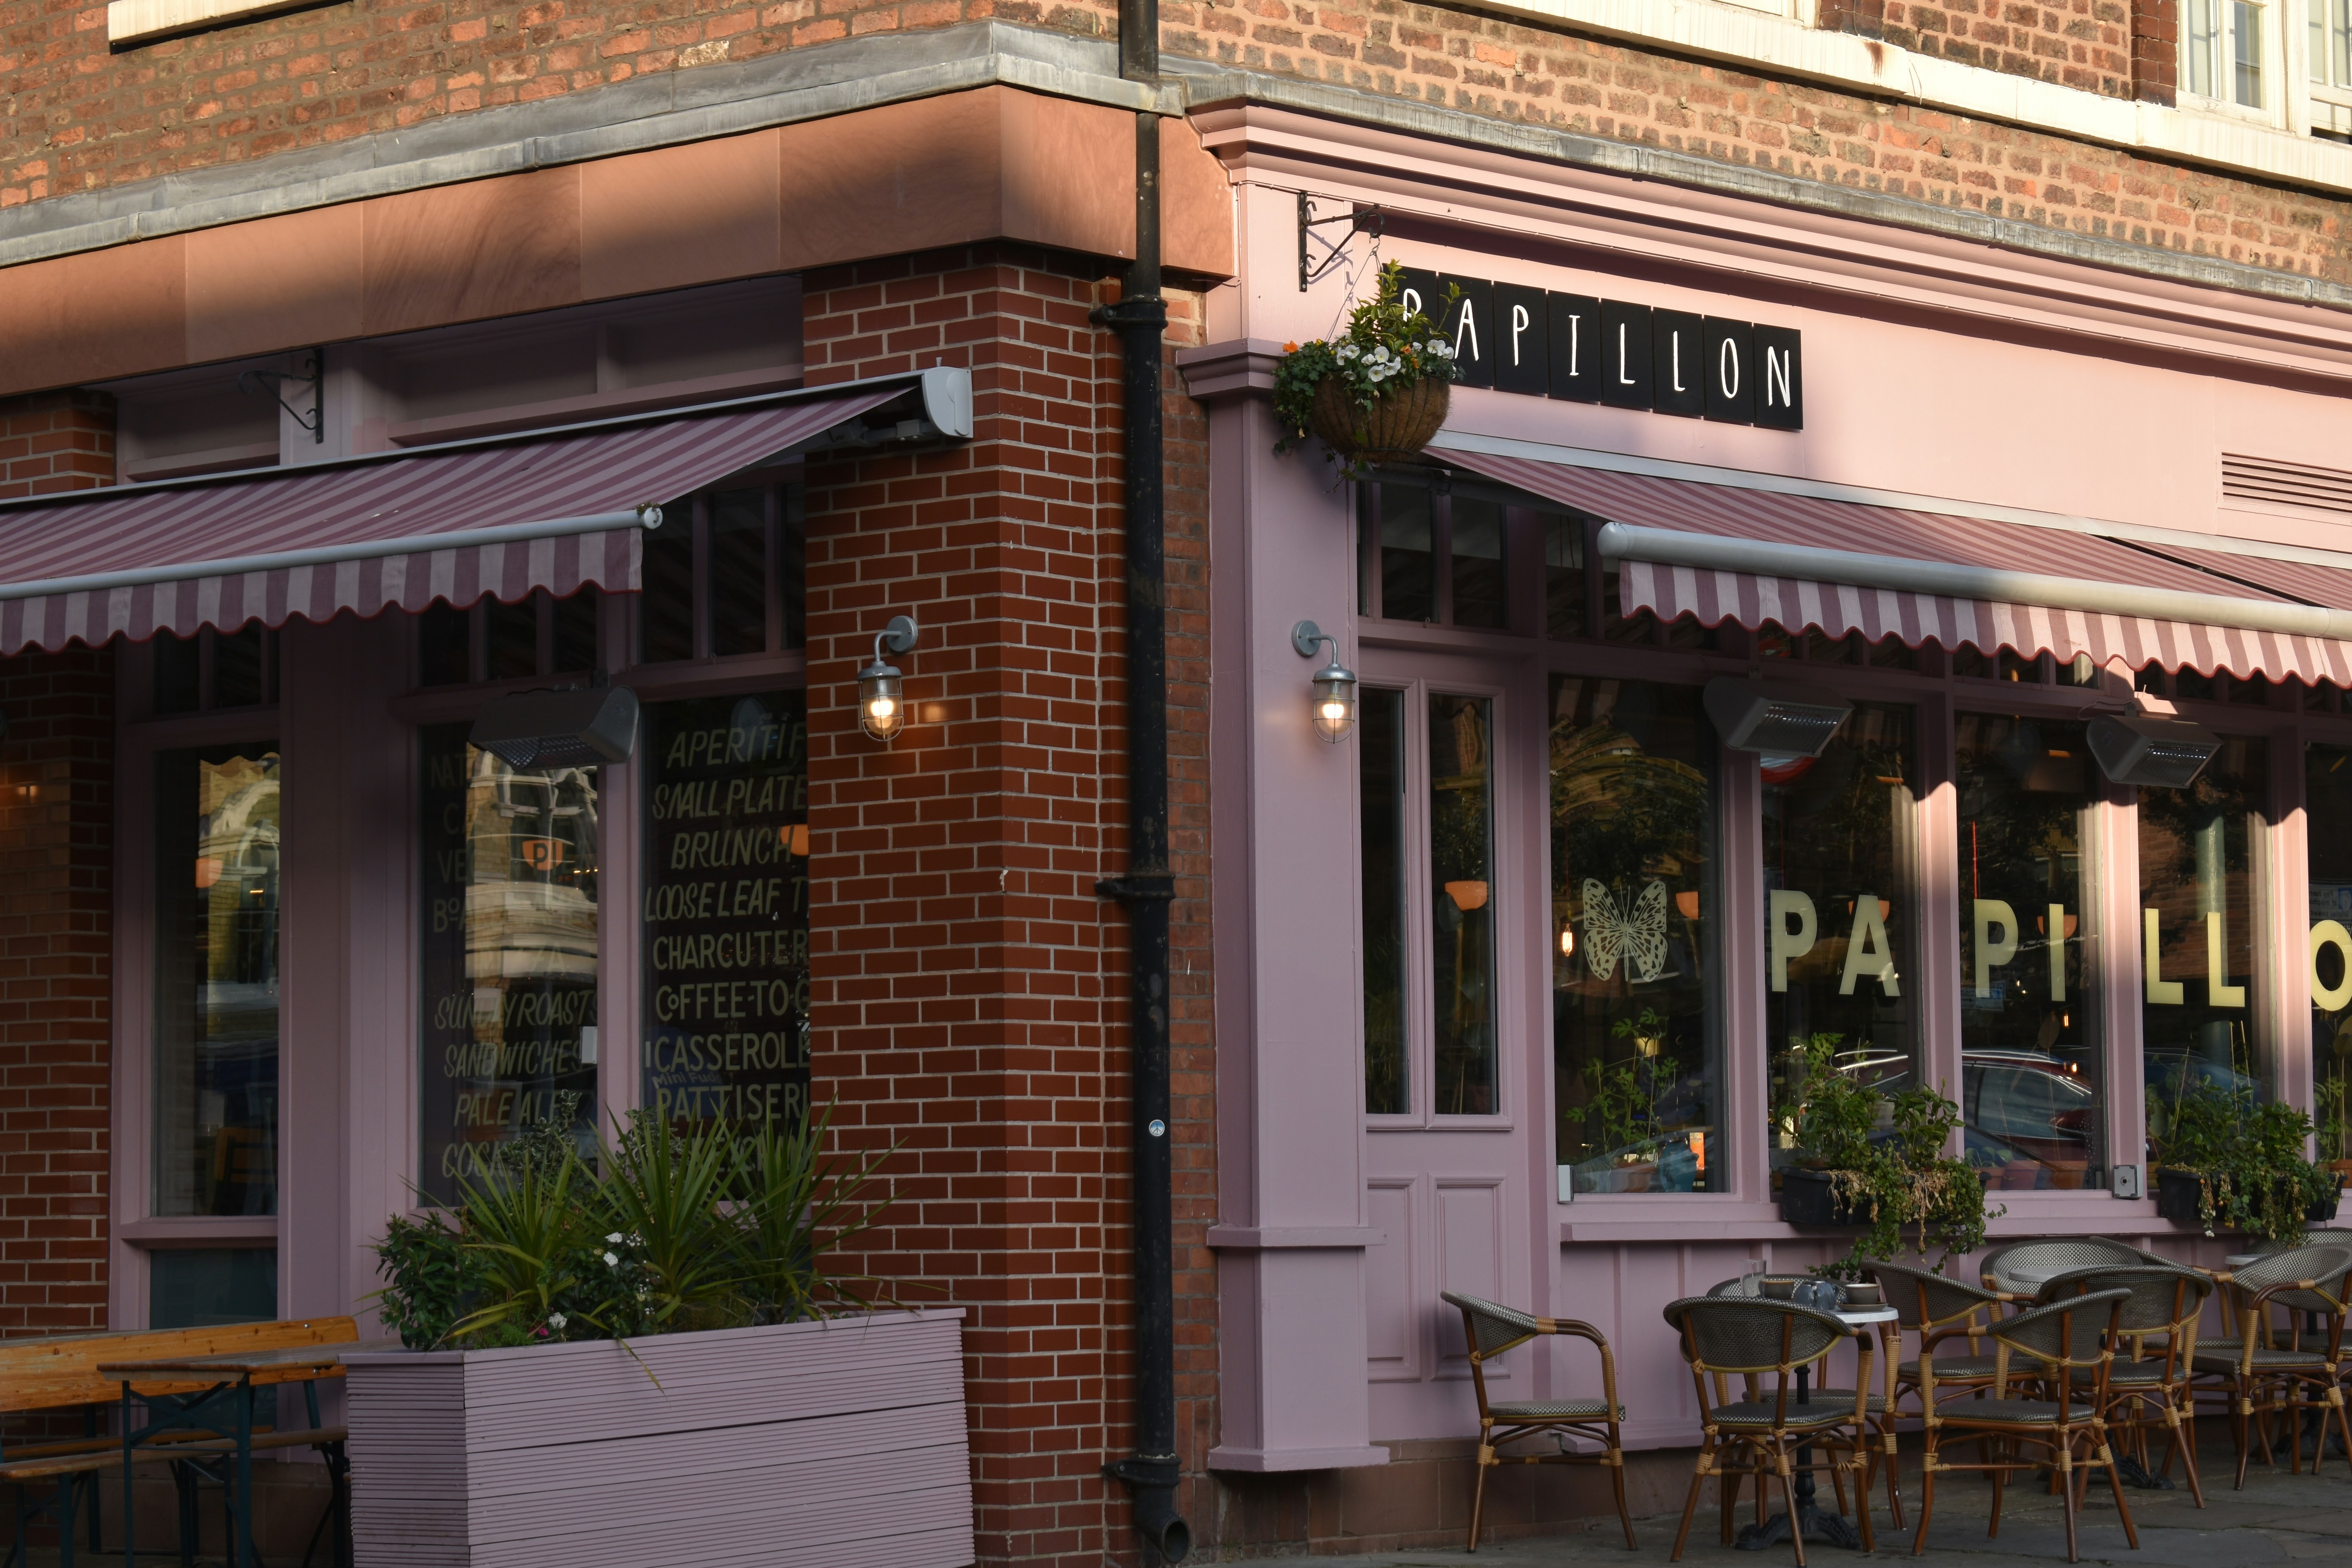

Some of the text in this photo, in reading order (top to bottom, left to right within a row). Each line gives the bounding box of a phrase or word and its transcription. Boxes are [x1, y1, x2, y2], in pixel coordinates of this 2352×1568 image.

[1403, 287, 1791, 408] PAPILLON
[652, 774, 807, 820] SMALL PLATE
[671, 825, 795, 870] BRUNCH
[645, 876, 808, 922] LOOSE LEAF T
[653, 929, 808, 971] CHARCUTER
[444, 1039, 583, 1078] SANDWICHES
[652, 1071, 687, 1088] Mini
[454, 1091, 514, 1127] PALE
[657, 1082, 808, 1123] PATTISERI
